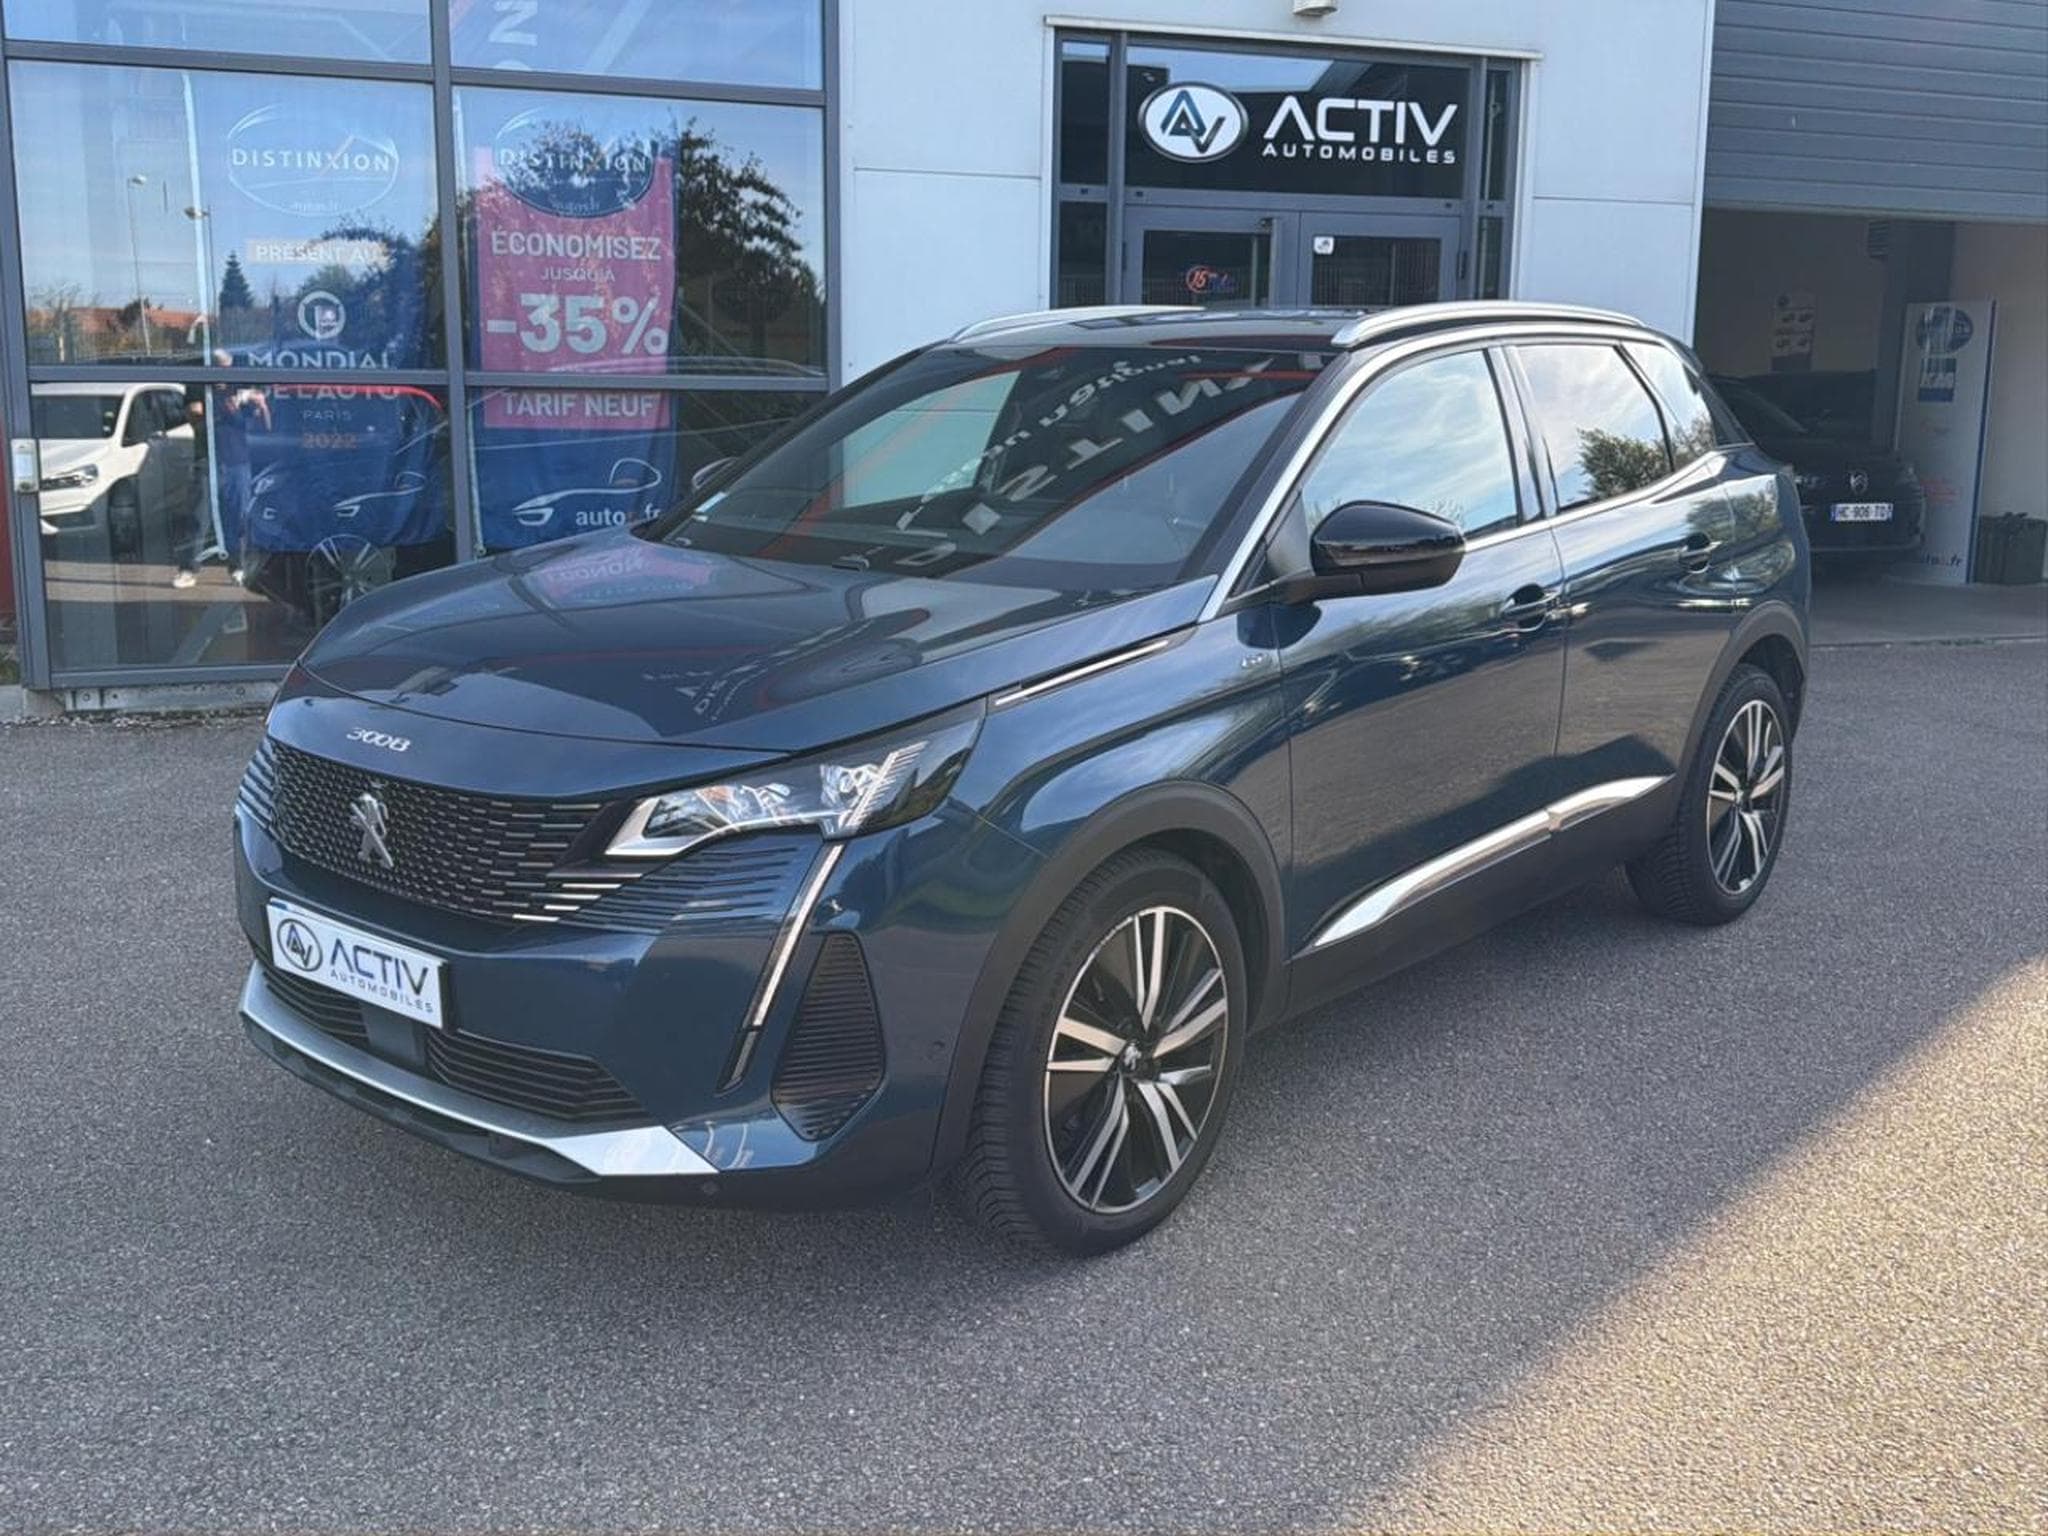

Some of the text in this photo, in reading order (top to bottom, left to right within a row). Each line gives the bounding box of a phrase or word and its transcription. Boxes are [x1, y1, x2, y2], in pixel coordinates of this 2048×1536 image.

[1263, 95, 1458, 146] ACTIV
[232, 147, 391, 173] DISTINXION
[1262, 142, 1456, 165] AUTOMOBILES
[491, 225, 661, 261] ÉCONOMISEZ
[487, 293, 669, 355] -35%
[503, 392, 659, 417] TARIF NEUF
[346, 727, 411, 752] 3008
[330, 937, 429, 996] ACTIV
[330, 968, 434, 1015] AUTOMOBILES
